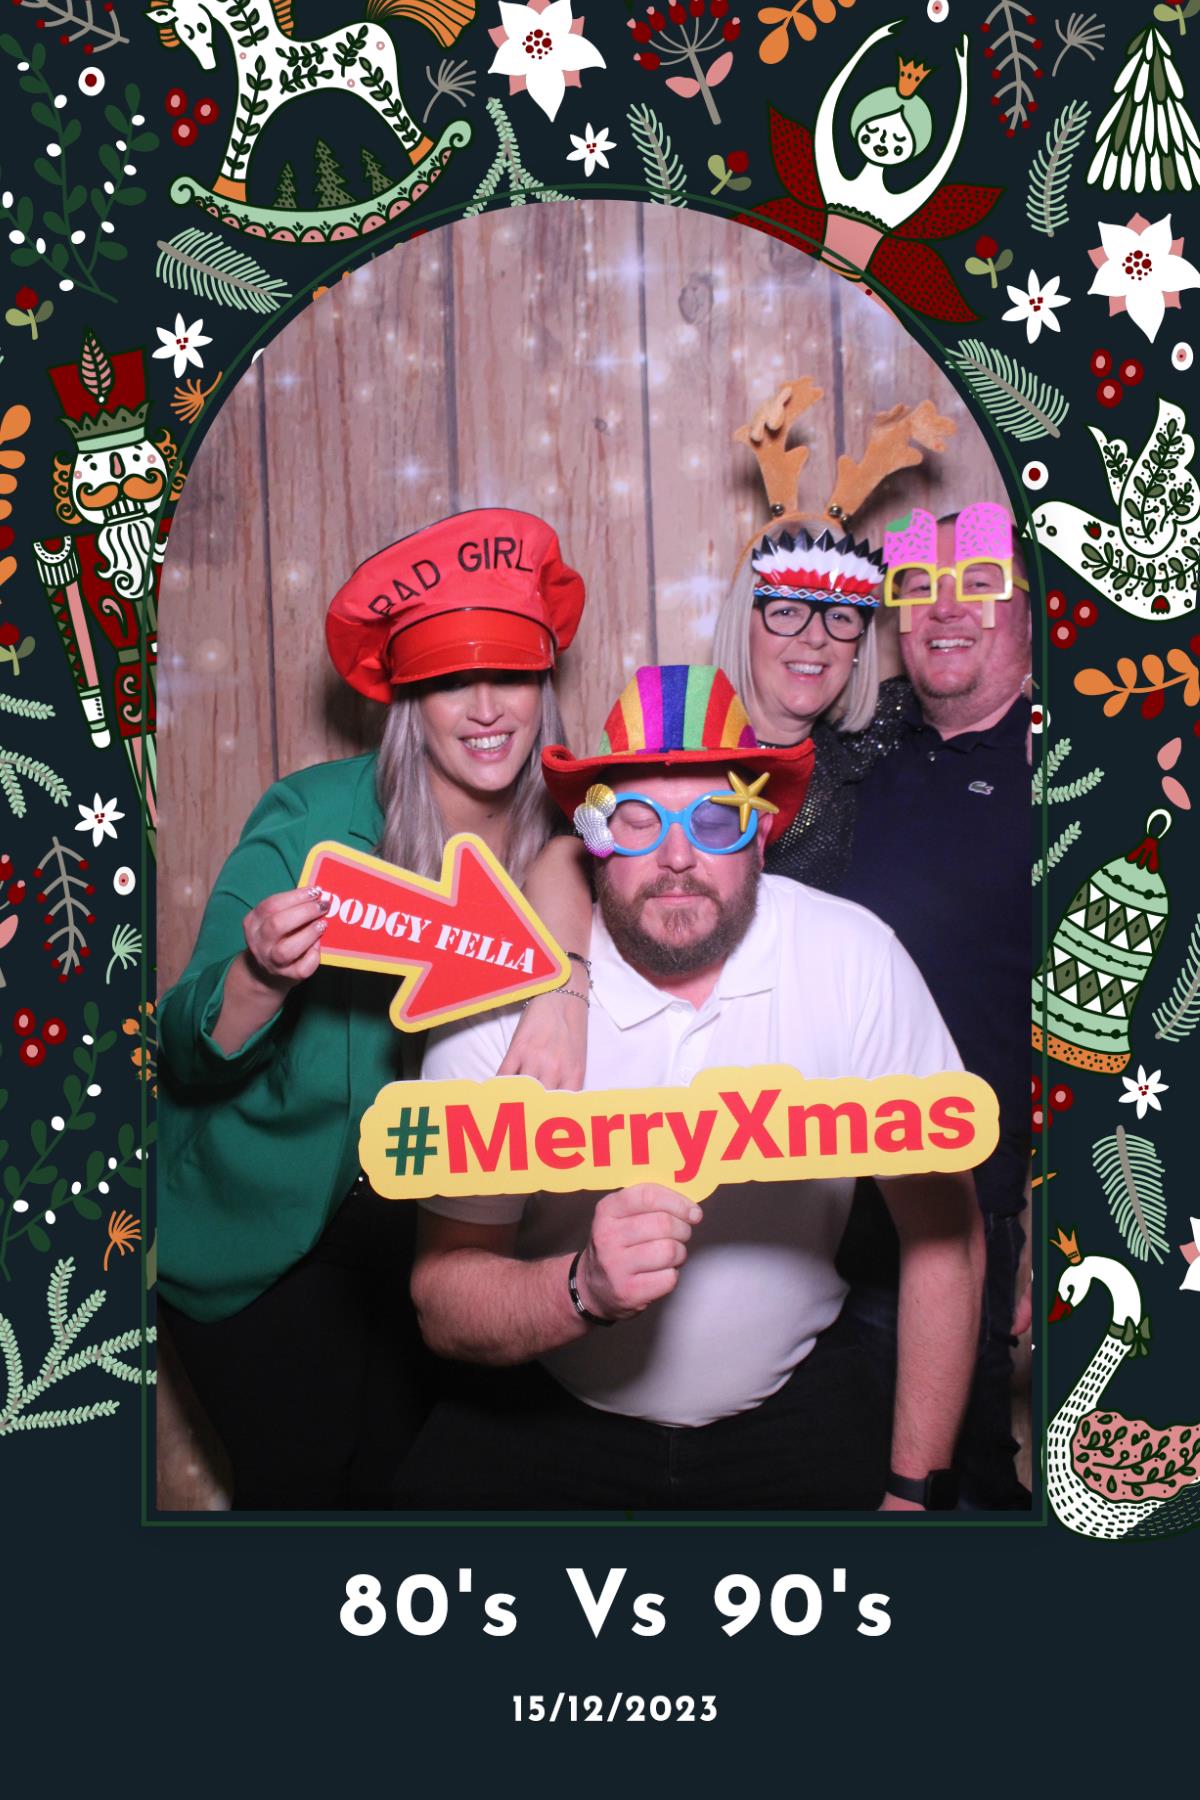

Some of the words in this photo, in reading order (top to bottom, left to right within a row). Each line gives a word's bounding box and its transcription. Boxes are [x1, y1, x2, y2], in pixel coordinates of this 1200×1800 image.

[457, 536, 534, 573] GIRL
[320, 890, 432, 944] DODGY
[434, 924, 535, 974] FELLA
[384, 1088, 976, 1184] #MerryXmas
